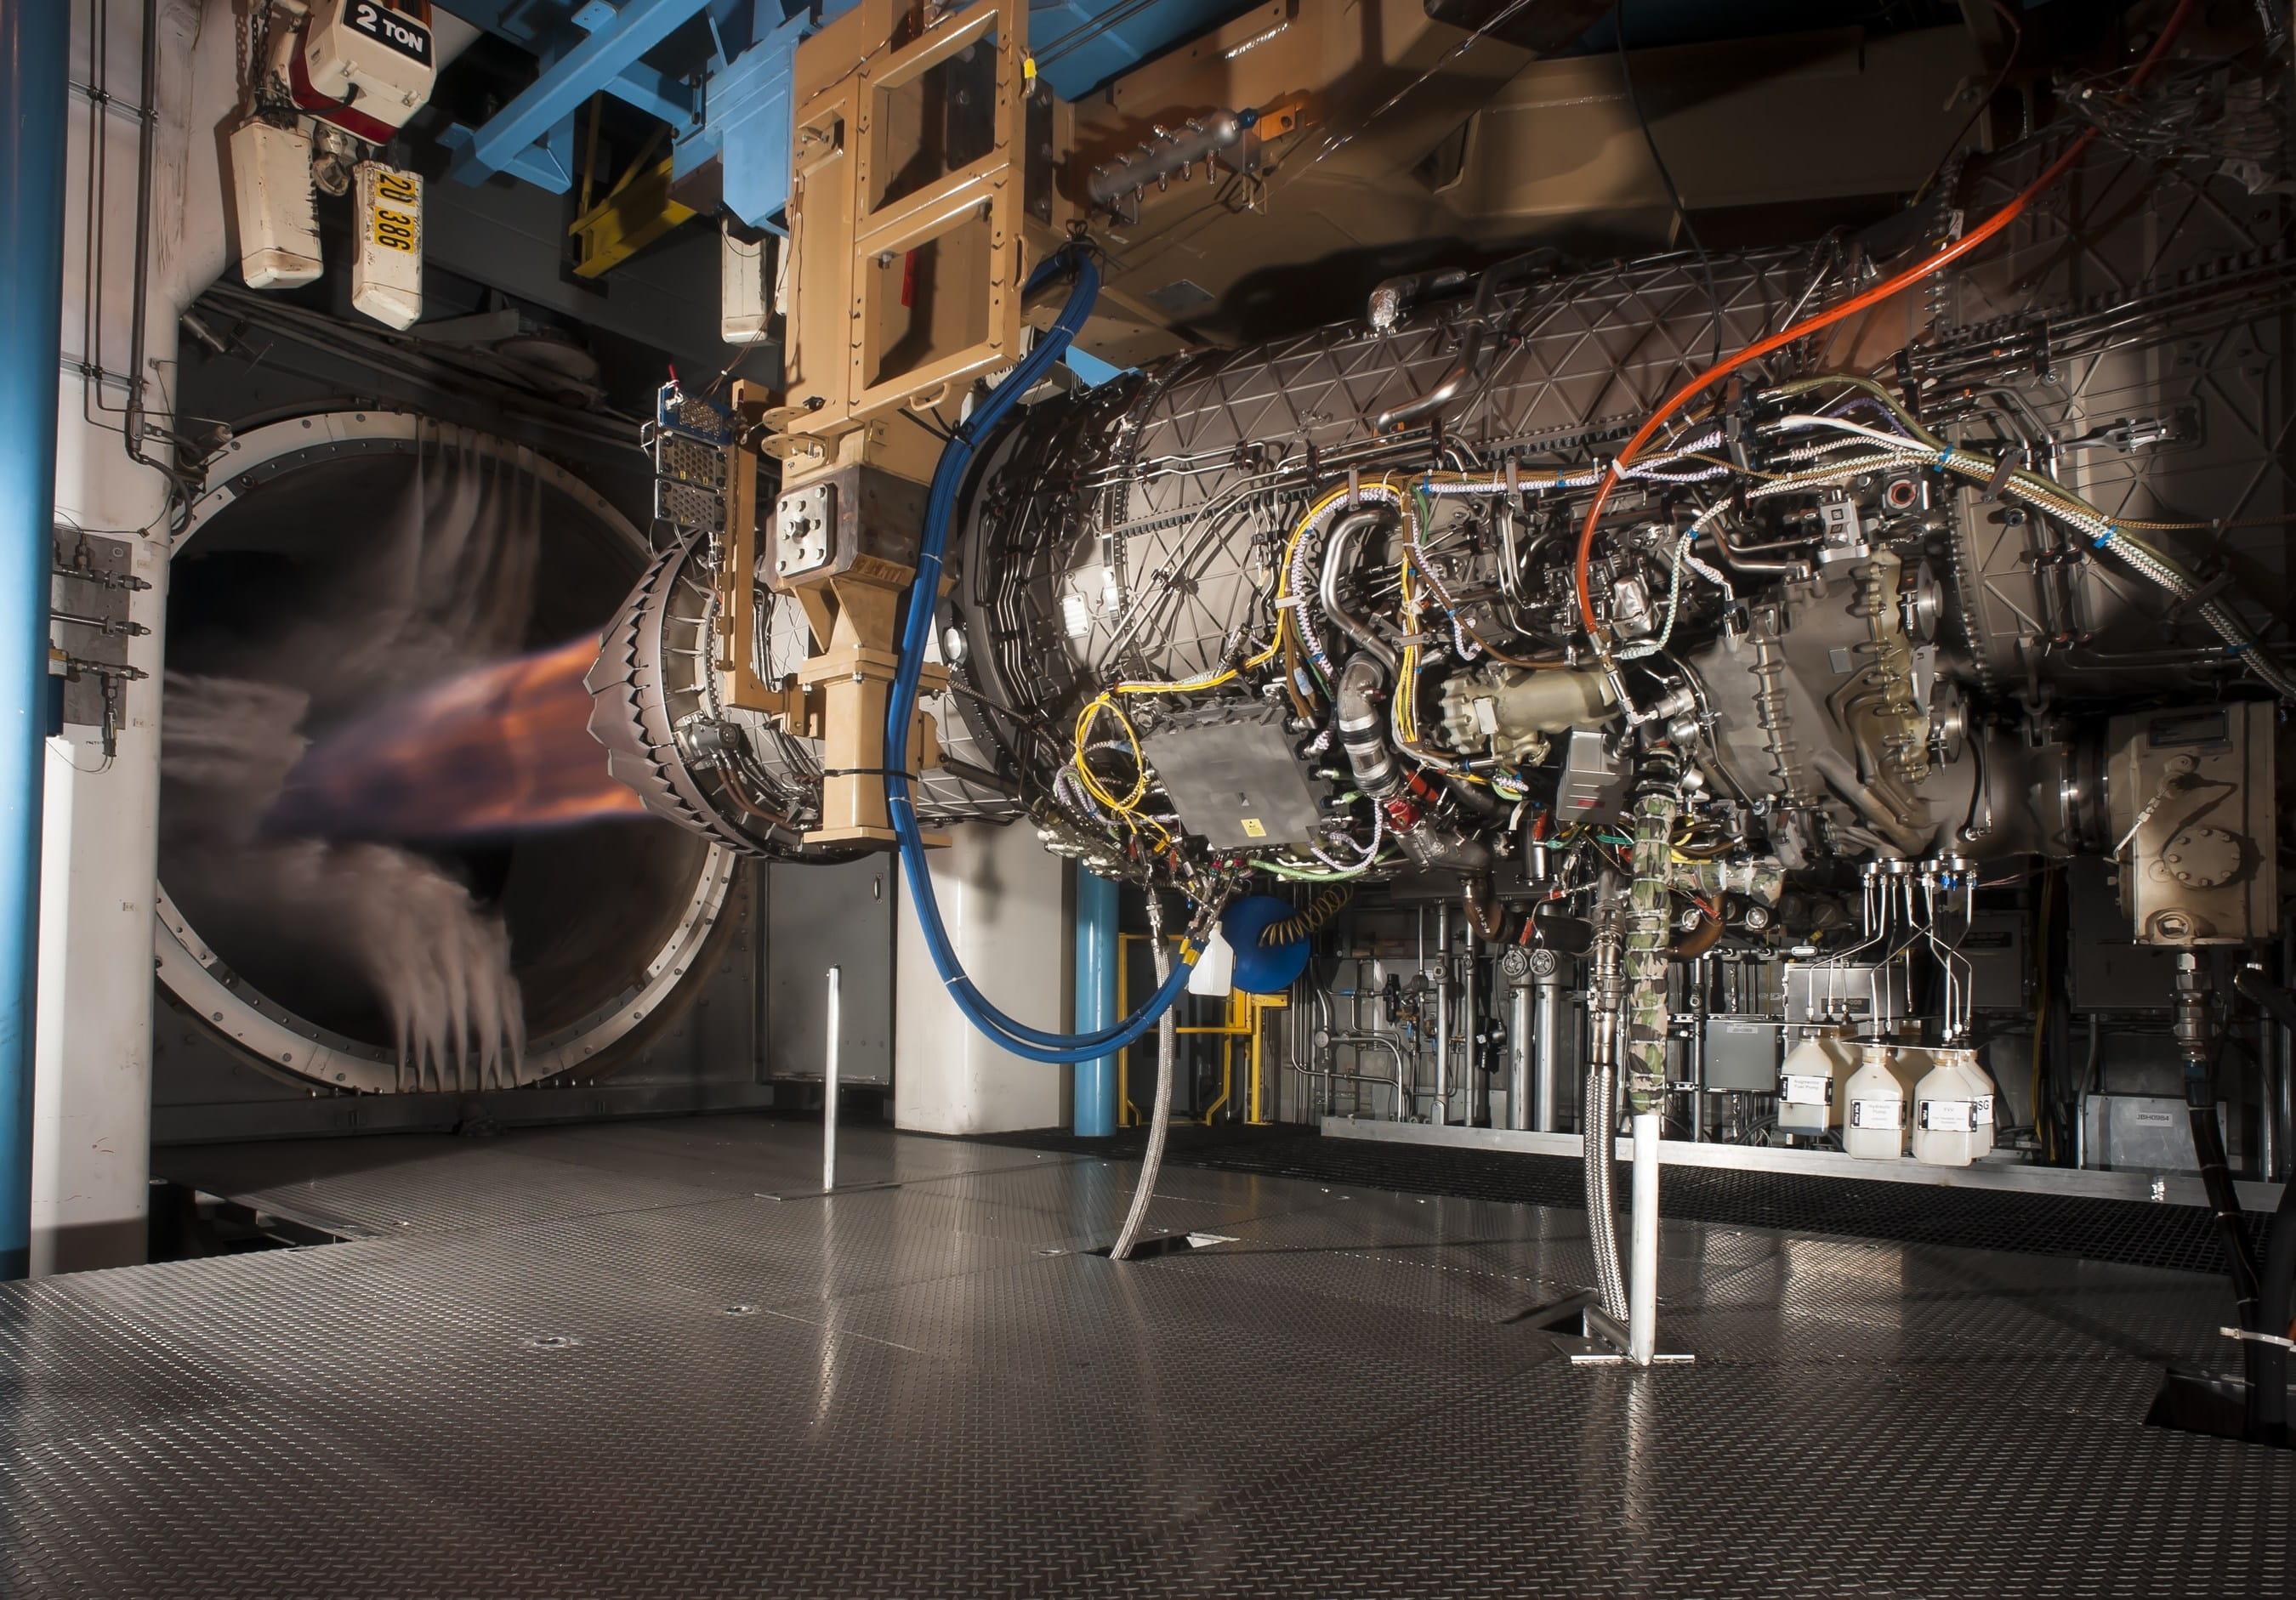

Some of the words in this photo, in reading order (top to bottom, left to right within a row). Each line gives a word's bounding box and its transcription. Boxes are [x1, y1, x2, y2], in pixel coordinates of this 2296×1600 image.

[356, 4, 378, 32] 2
[383, 20, 423, 53] TON
[379, 173, 412, 204] 20
[378, 210, 411, 250] 386
